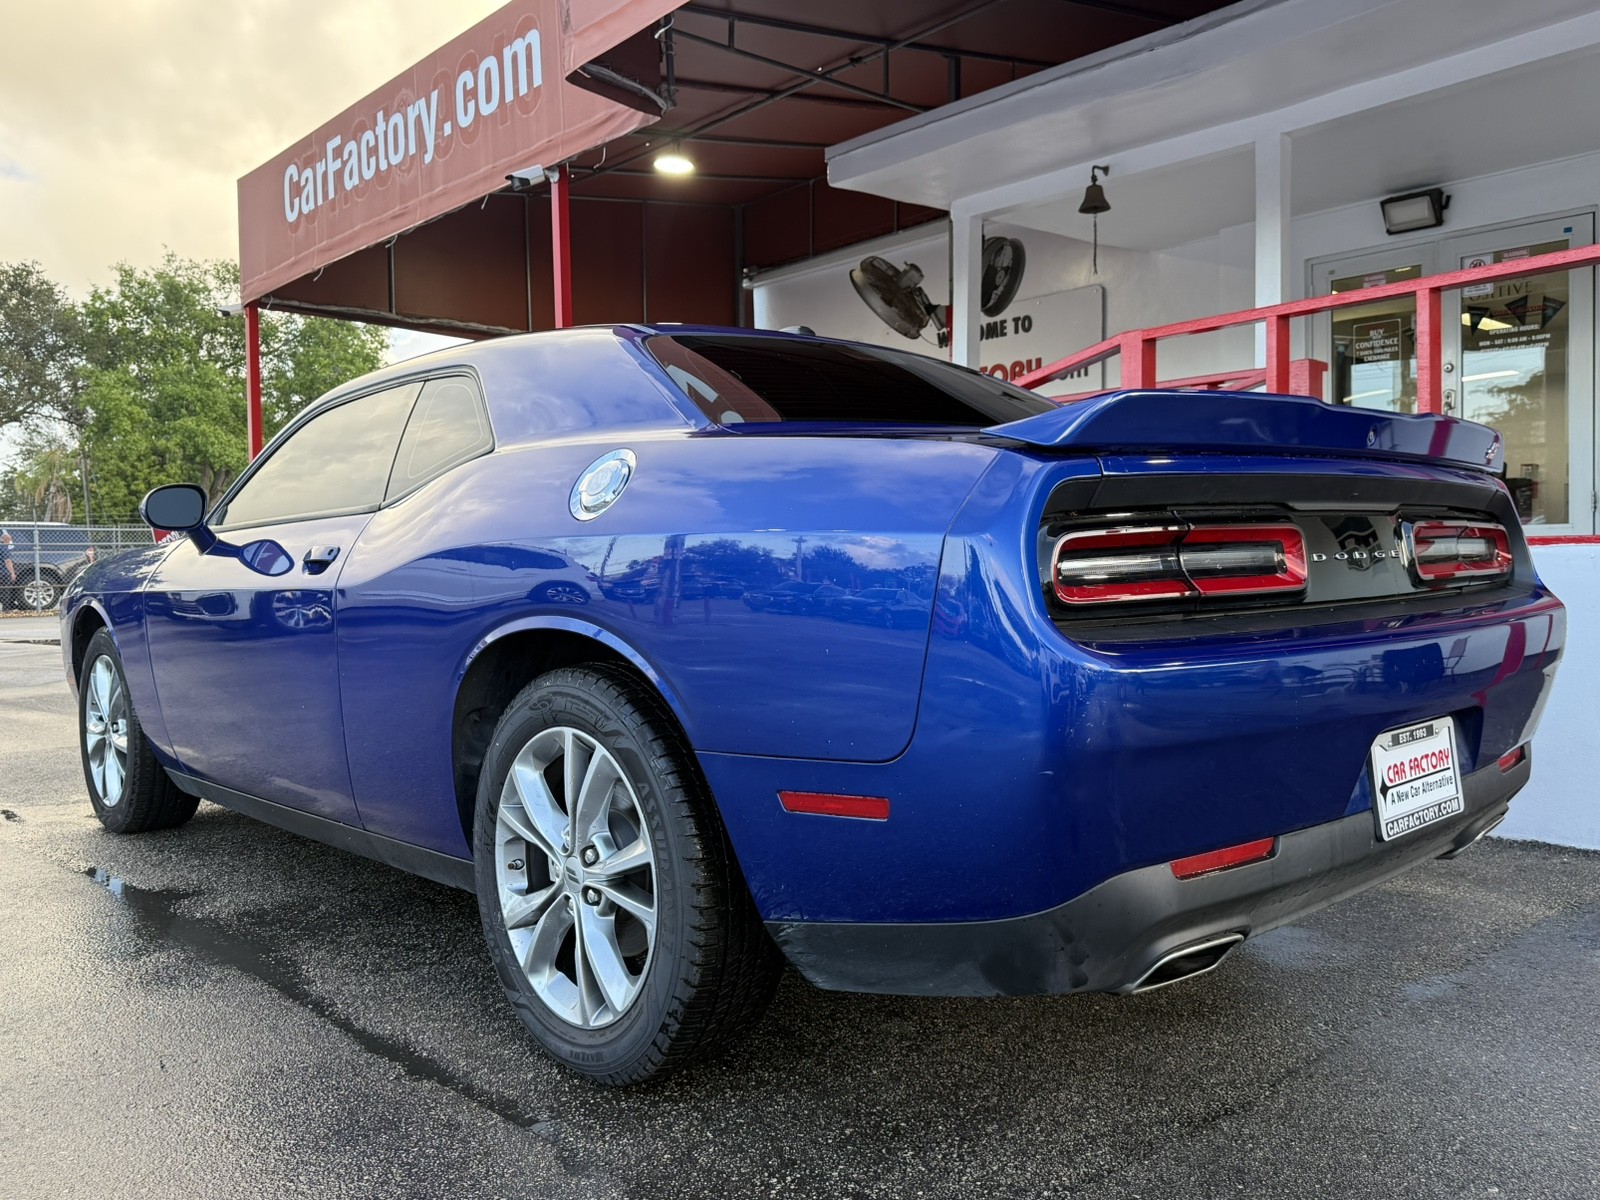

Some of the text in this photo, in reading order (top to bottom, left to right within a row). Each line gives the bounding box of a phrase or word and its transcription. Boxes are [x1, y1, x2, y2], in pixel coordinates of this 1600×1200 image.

[283, 28, 543, 223] CarFactory.com
[1012, 314, 1033, 335] TO
[1355, 338, 1399, 349] CONFIDENCE
[1364, 353, 1391, 362] EXCHANGE
[1311, 549, 1400, 562] DODGE
[1399, 732, 1412, 743] EST.
[1387, 747, 1450, 784] CAR FACTORY
[1391, 775, 1454, 806] A New Car Alternative
[1386, 798, 1460, 836] CARFACTORY.COM
